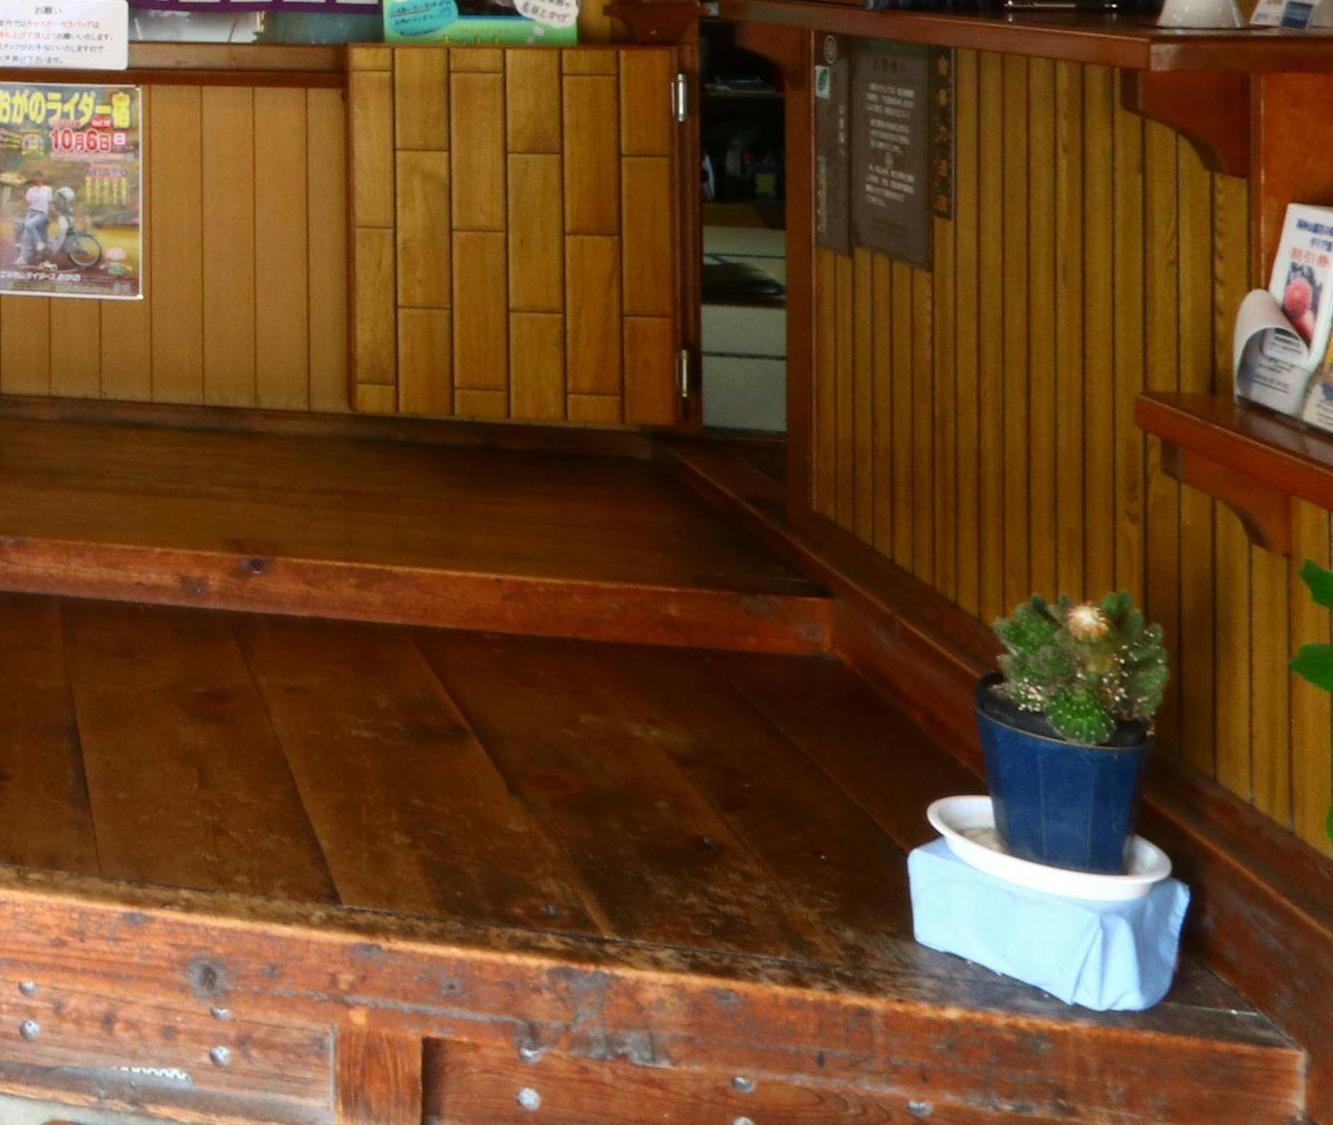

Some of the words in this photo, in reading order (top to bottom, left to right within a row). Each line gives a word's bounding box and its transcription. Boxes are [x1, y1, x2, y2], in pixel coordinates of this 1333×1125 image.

[35, 6, 62, 15] お願い
[50, 128, 112, 152] 10月6日
